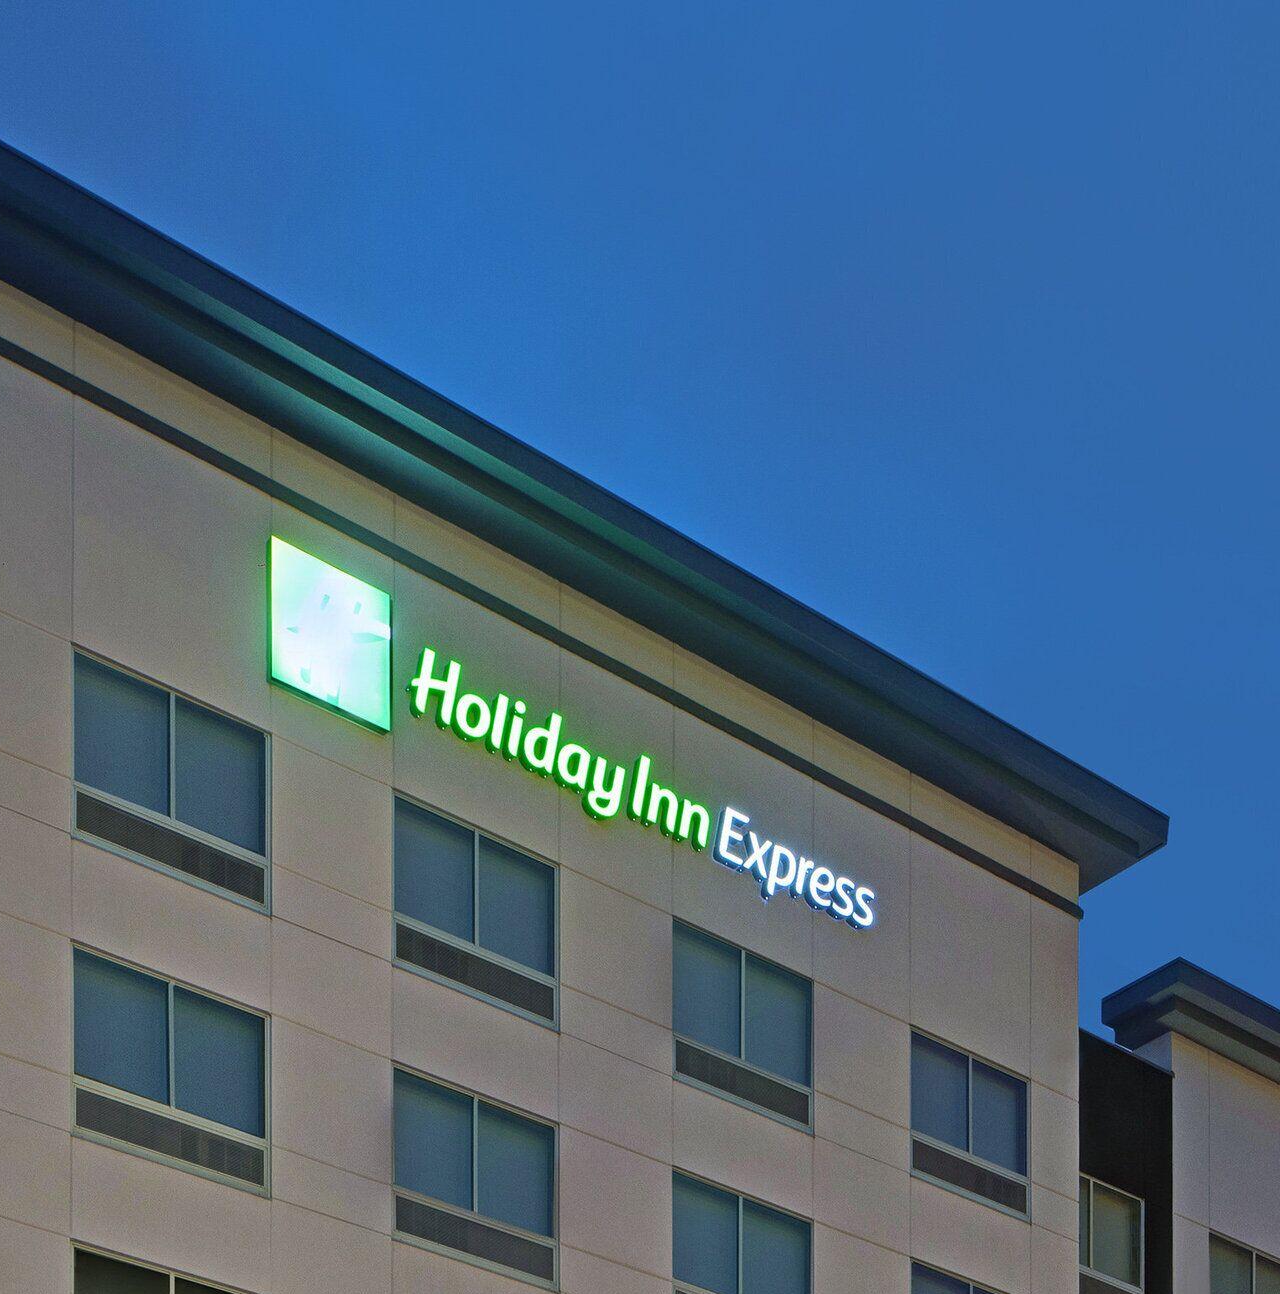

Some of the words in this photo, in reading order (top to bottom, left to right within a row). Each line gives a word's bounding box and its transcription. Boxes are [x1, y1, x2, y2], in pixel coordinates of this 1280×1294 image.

[409, 646, 626, 818] Holiday
[630, 754, 710, 849] Inn
[716, 805, 876, 928] Express
